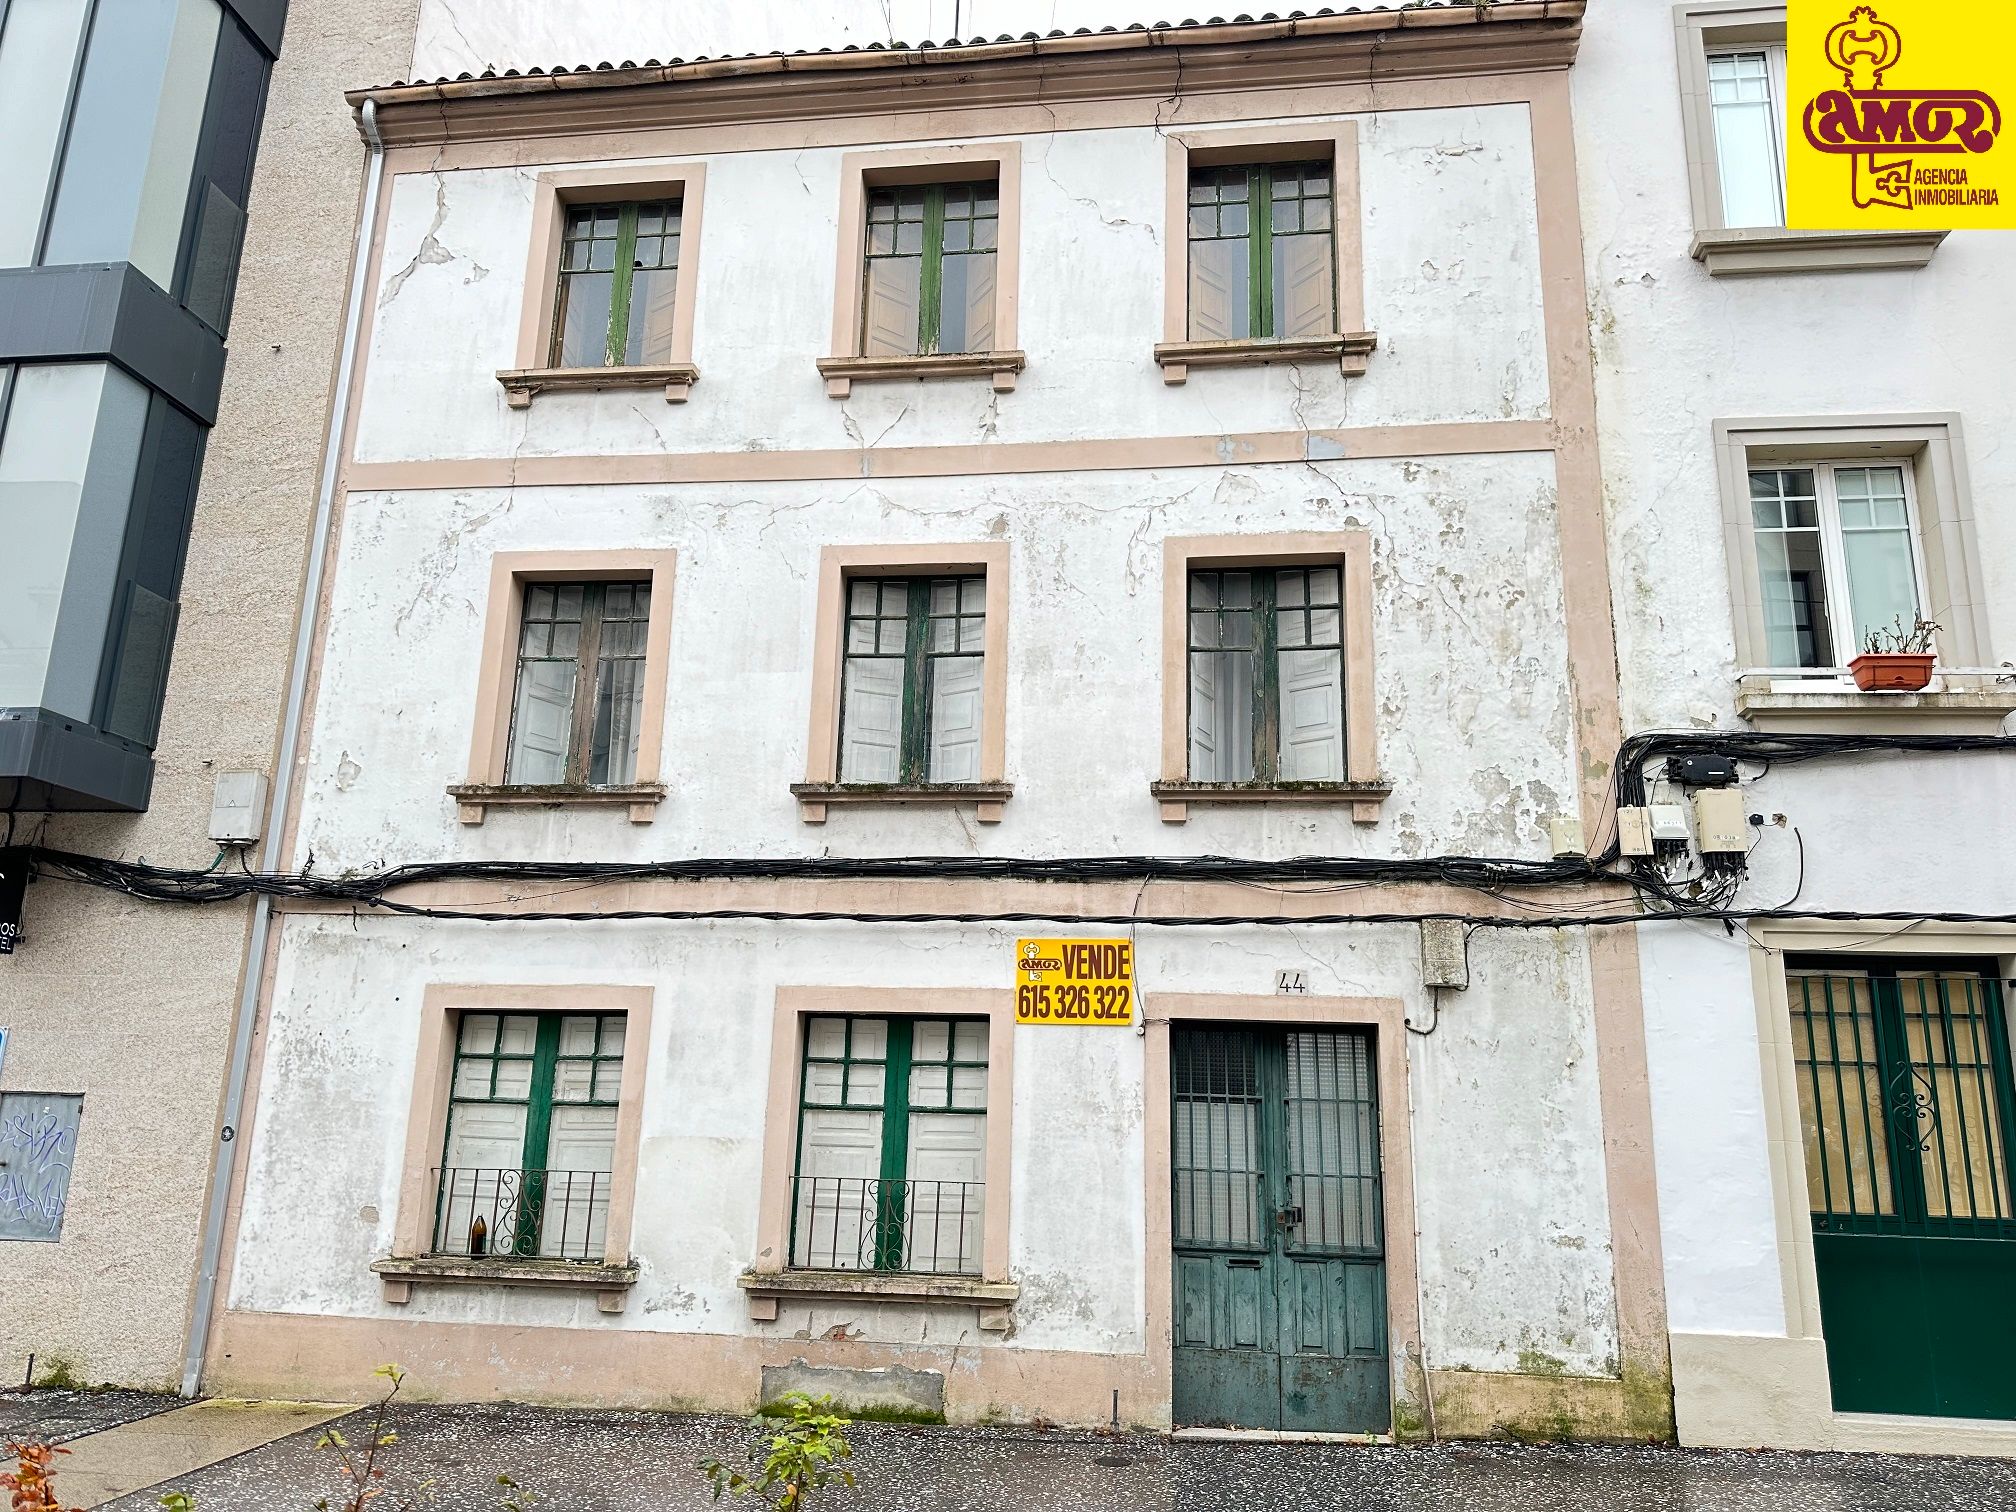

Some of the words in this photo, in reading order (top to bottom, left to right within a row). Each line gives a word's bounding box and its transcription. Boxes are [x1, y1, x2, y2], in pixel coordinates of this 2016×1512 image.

[0, 922, 16, 937] OS
[0, 936, 11, 950] EL
[1020, 958, 1062, 971] AMOR
[1062, 944, 1130, 980] VENDE
[1279, 972, 1306, 994] 44
[1018, 984, 1051, 1019] 615
[1054, 984, 1090, 1019] 326
[1093, 985, 1130, 1019] 322
